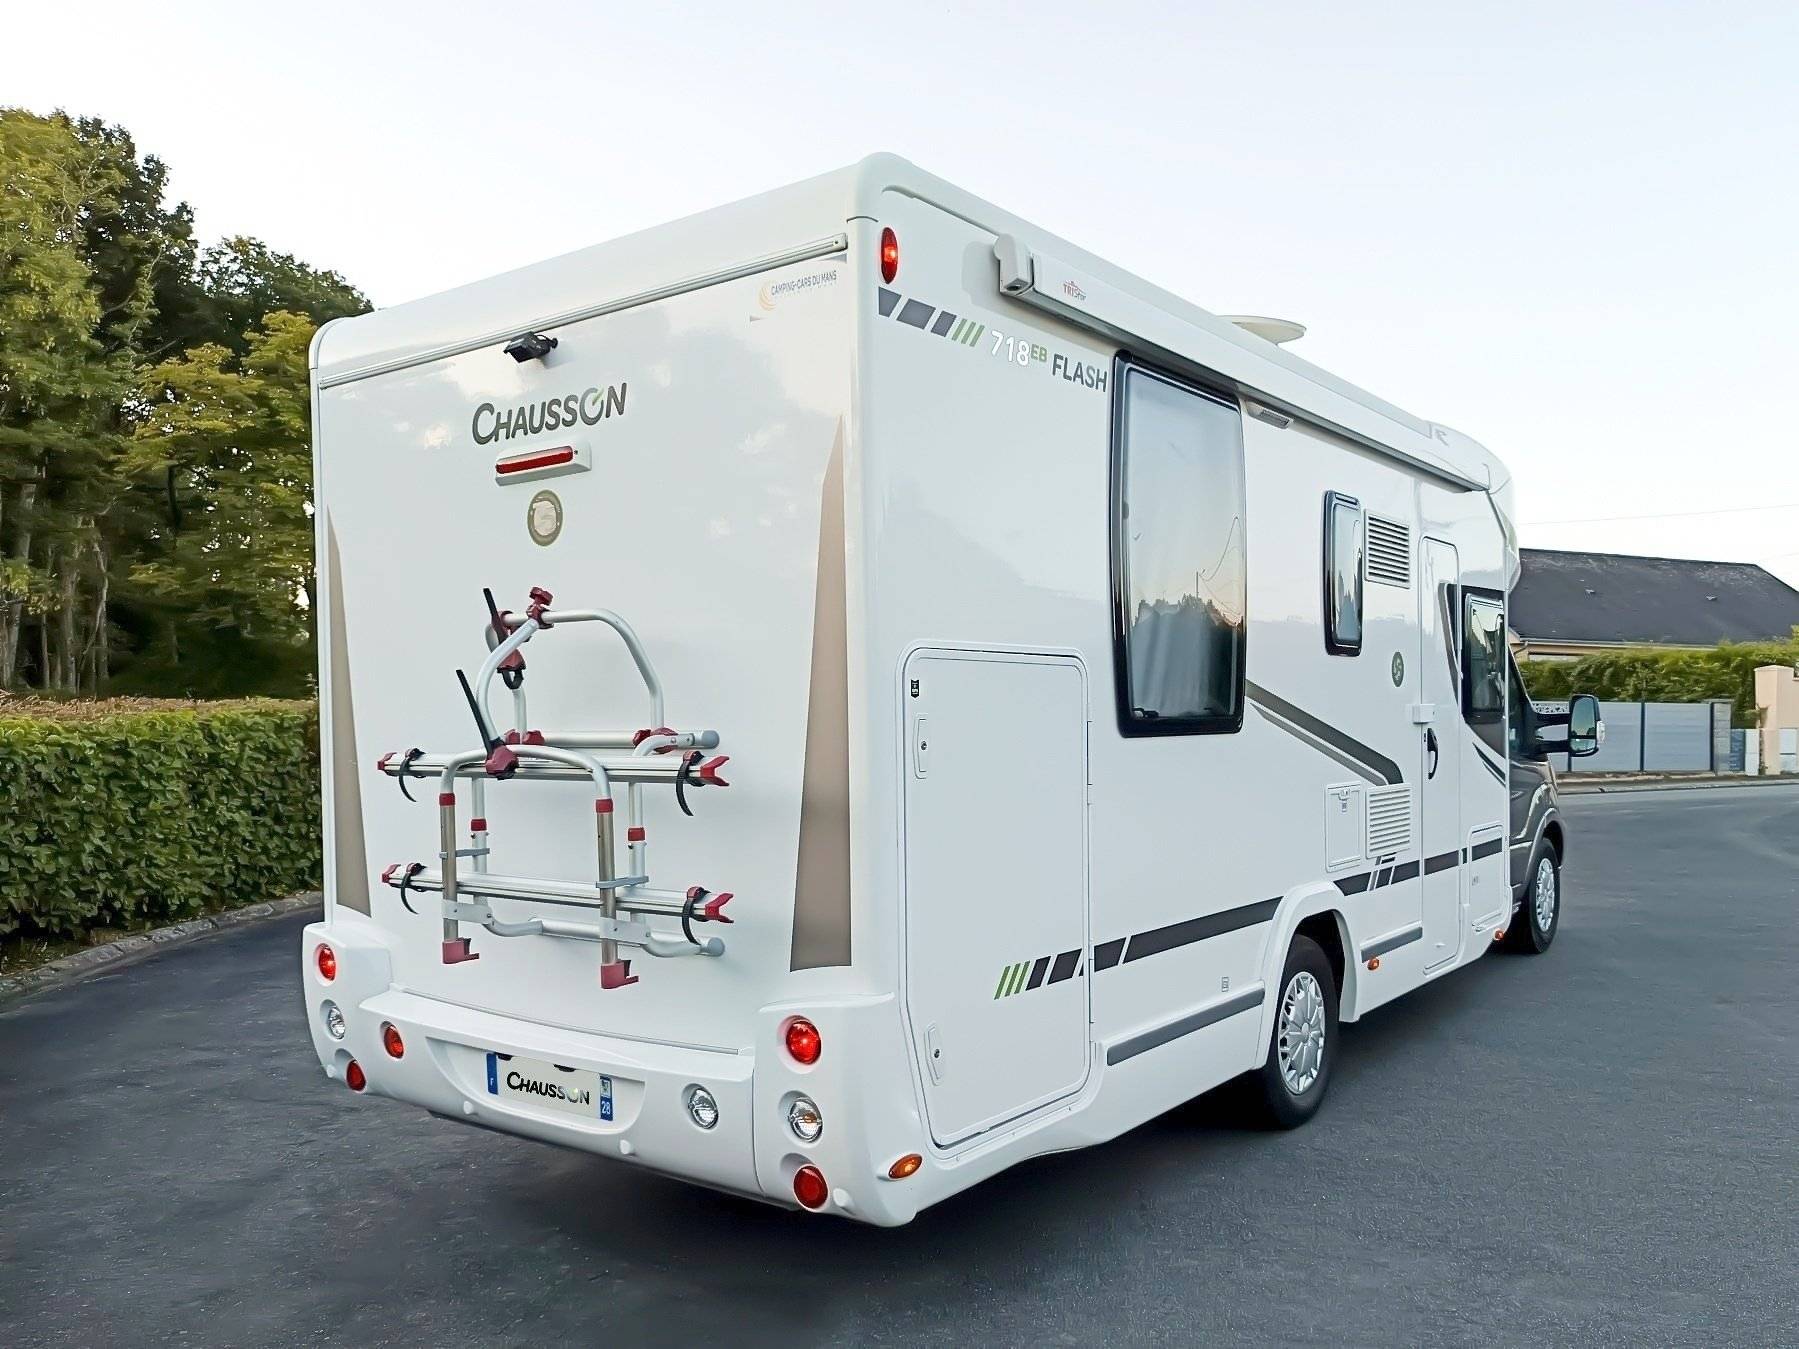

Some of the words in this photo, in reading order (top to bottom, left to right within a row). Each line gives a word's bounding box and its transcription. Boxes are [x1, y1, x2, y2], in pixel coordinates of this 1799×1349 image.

[771, 276, 811, 295] CAMPING-CARS
[812, 275, 821, 286] DU
[821, 270, 837, 284] MANS
[1052, 353, 1107, 392] FLASH
[472, 382, 627, 445] CHAUSSON
[506, 1071, 590, 1105] CHAUSSON
[601, 1100, 611, 1115] 28
